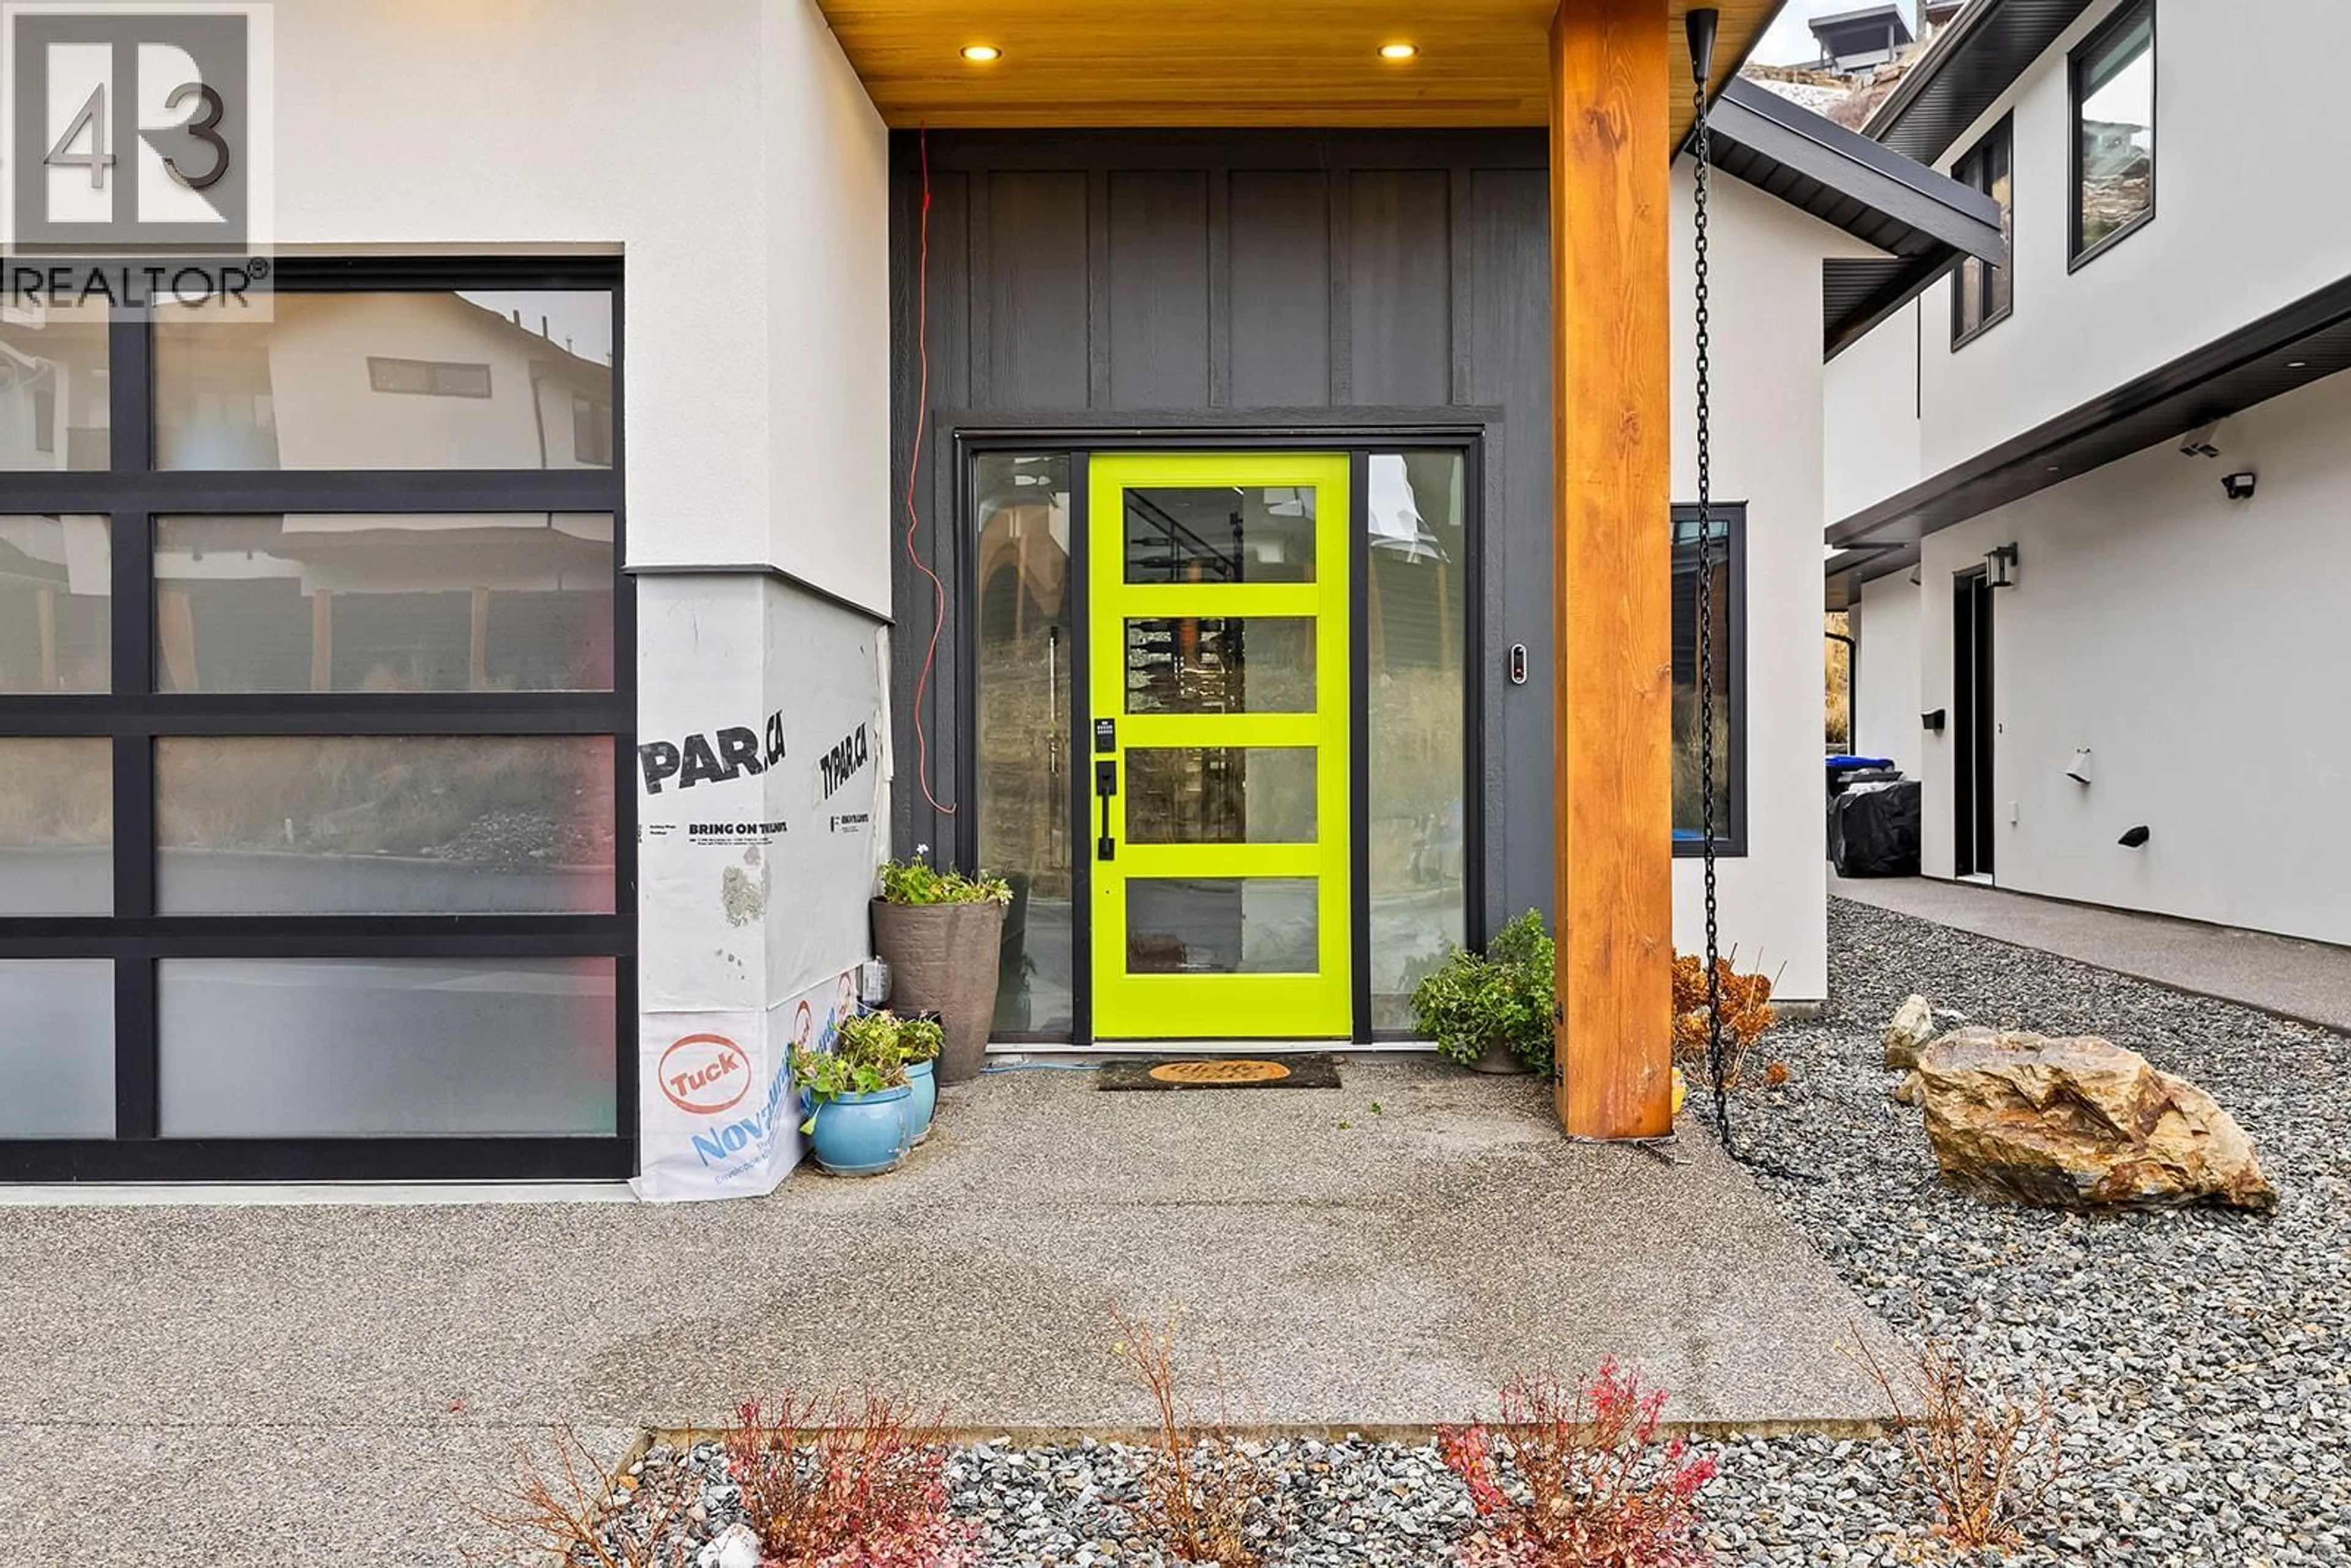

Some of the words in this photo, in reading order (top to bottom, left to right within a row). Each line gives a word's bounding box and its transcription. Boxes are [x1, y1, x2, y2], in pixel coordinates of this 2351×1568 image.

[43, 82, 229, 189] 43
[820, 722, 868, 800] TYPAR.CA
[689, 823, 733, 835] BRING
[736, 823, 758, 835] ON
[670, 1051, 740, 1097] Tuck
